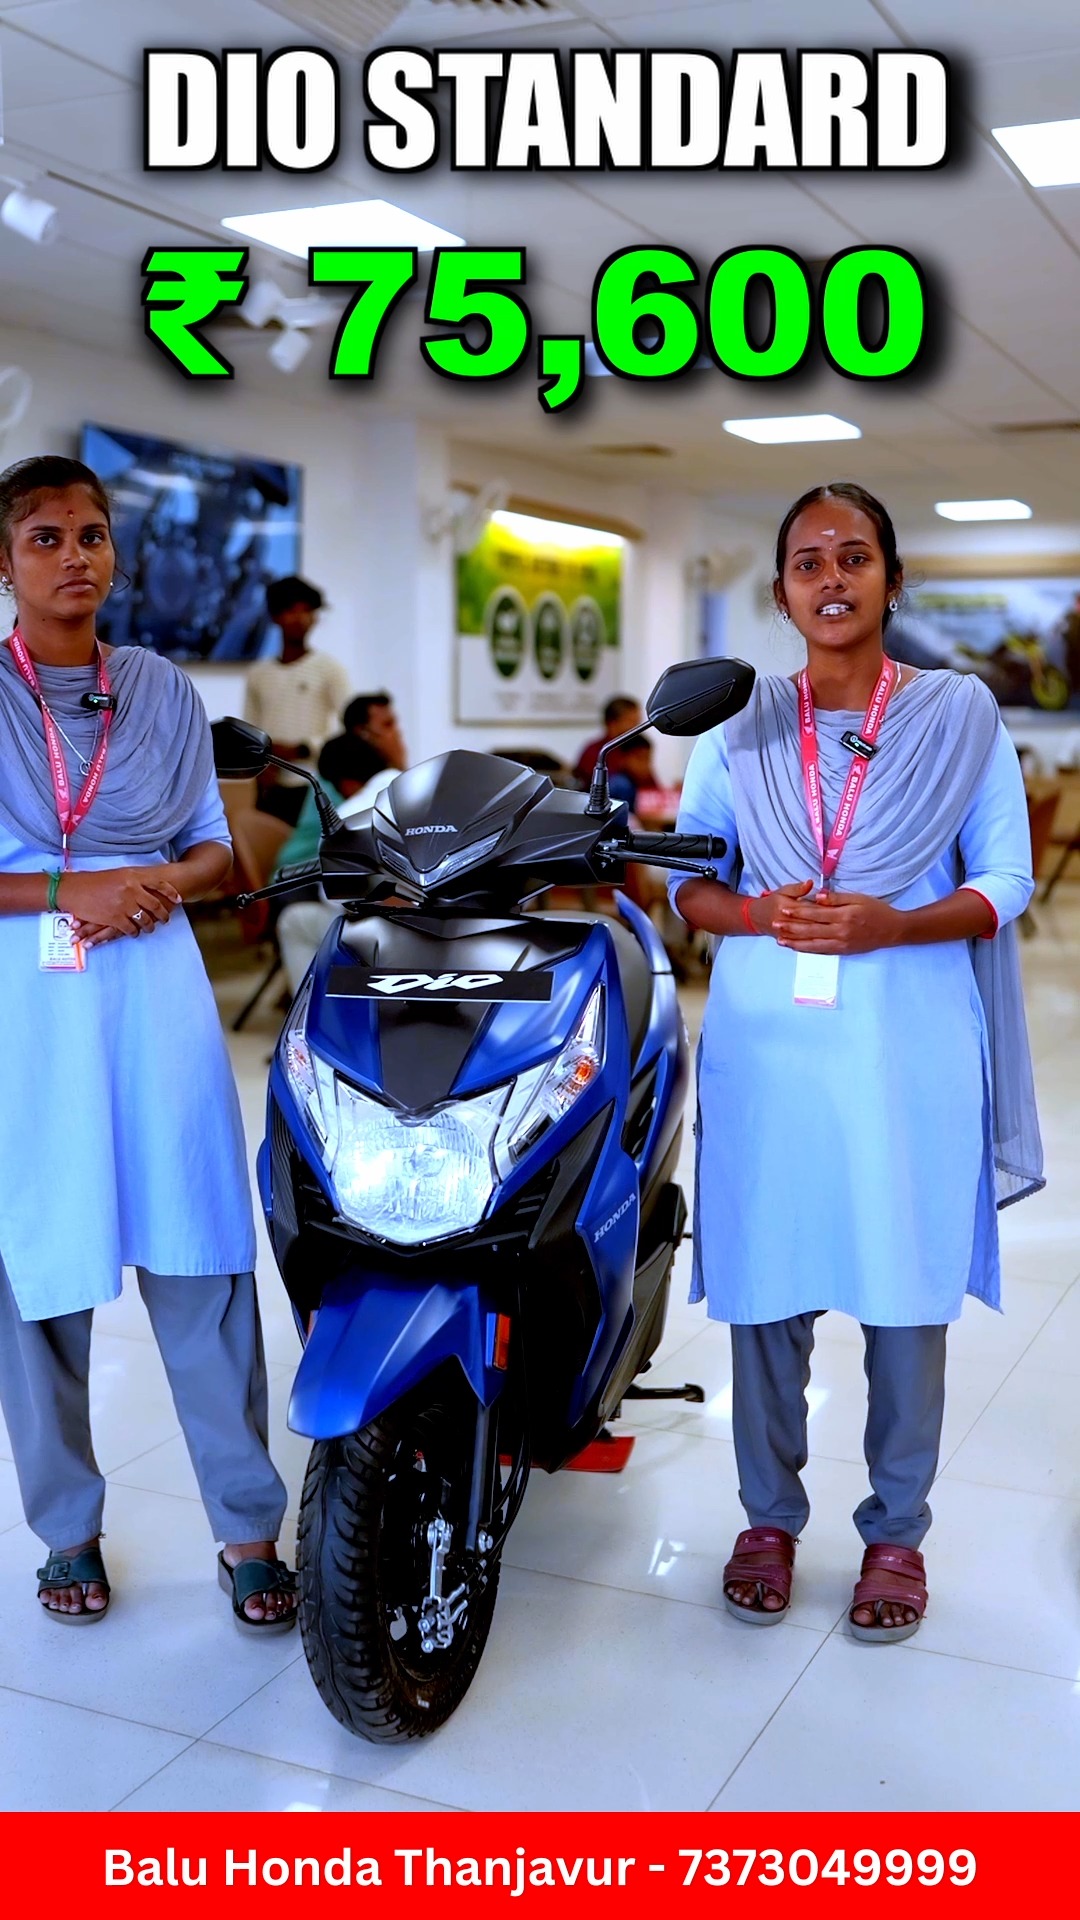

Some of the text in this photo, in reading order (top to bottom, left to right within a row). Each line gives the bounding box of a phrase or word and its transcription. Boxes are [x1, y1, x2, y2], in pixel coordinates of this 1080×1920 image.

[12, 635, 27, 664] HONDA
[803, 701, 812, 724] BALU
[864, 680, 888, 735] BALU HONDA
[54, 761, 65, 787] BALU
[82, 772, 99, 803] HONDA
[808, 763, 818, 797] HONDA
[835, 775, 859, 836] BALU HONDA
[404, 824, 459, 836] HONDA
[593, 1192, 637, 1244] HONDA
